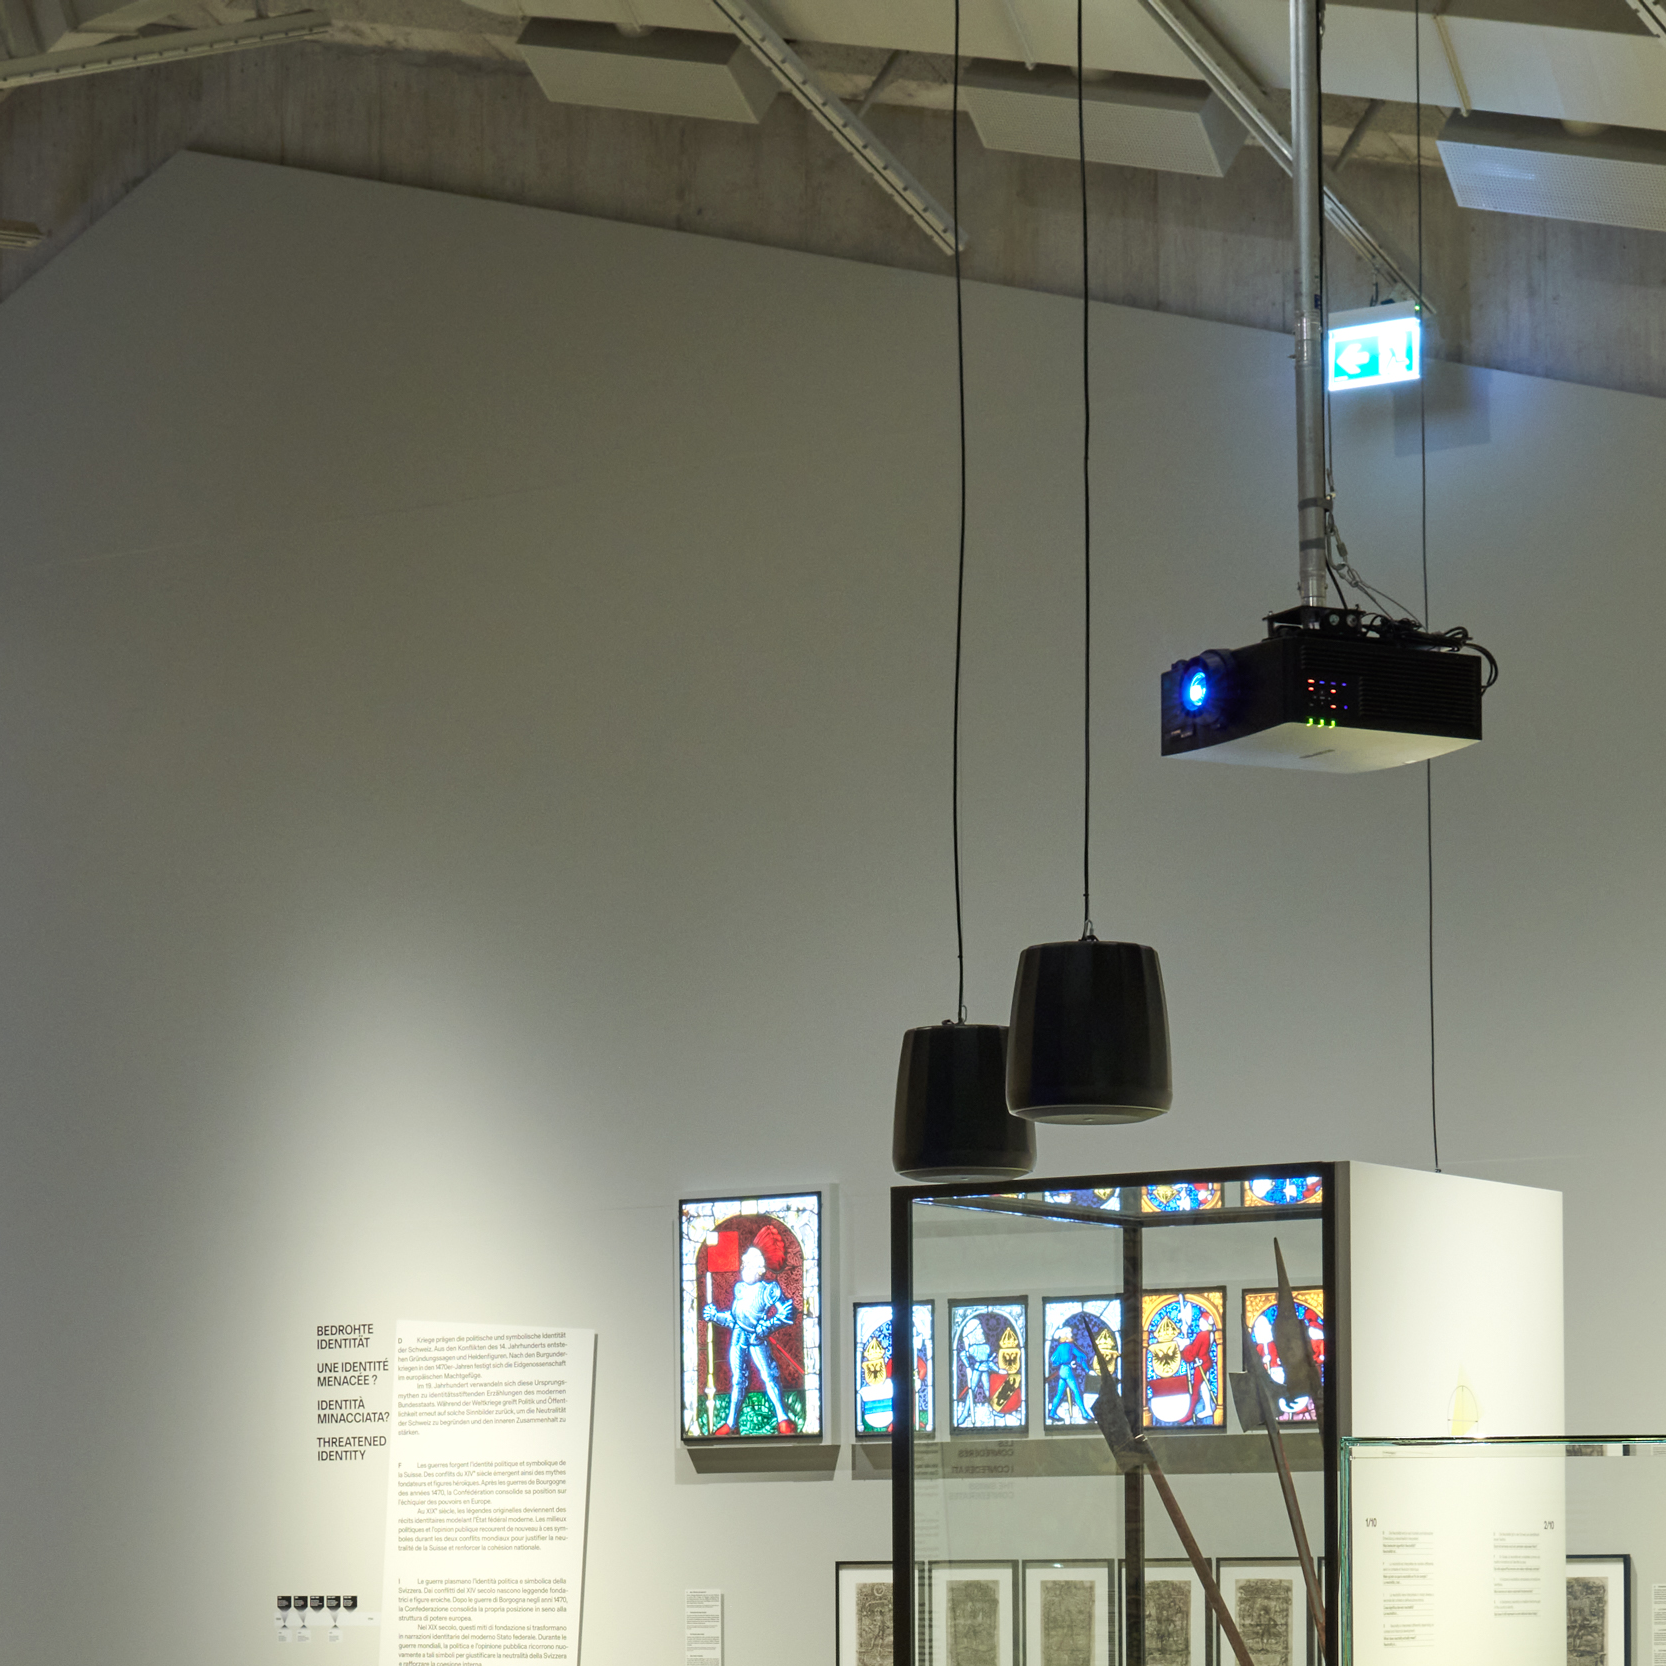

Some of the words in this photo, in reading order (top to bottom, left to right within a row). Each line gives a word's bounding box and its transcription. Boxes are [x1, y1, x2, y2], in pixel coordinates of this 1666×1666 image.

[317, 1324, 373, 1336] BEDROHTE
[317, 1335, 370, 1349] IDENTITÄT
[435, 1336, 455, 1344] prägen
[465, 1335, 493, 1343] politische
[535, 1351, 568, 1360] Burgunder-
[317, 1362, 339, 1373] UNE
[342, 1358, 388, 1372] IDENTITÉ
[317, 1372, 369, 1387] MENACÉE
[318, 1396, 365, 1410] IDENTITÀ
[318, 1412, 390, 1424] MINACCIATA?
[317, 1436, 386, 1447] THREATENED
[318, 1450, 366, 1461] IDENTITY
[1366, 1518, 1377, 1527] 1/10
[1544, 1520, 1554, 1529] 2/10
